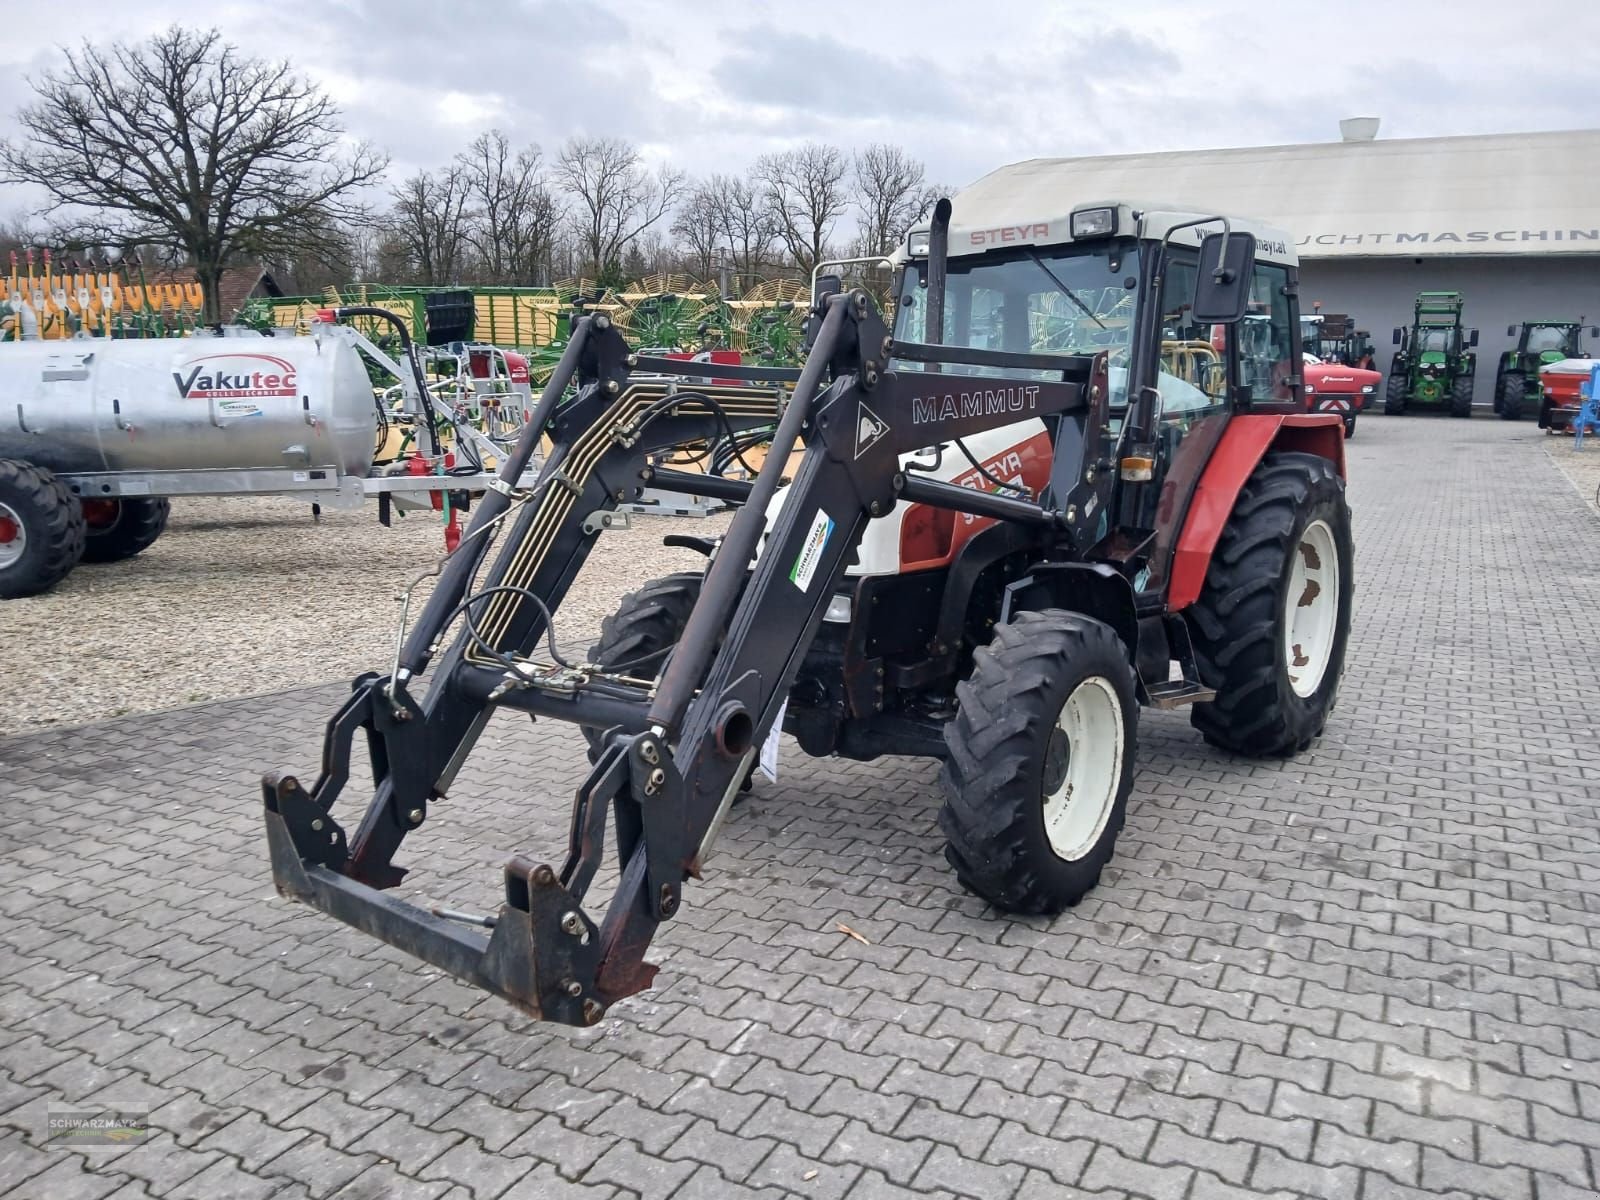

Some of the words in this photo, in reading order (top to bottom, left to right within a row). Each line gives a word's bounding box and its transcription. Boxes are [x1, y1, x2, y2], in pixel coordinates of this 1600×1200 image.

[970, 223, 1049, 245] STEYR
[172, 365, 297, 399] Vakutec
[912, 385, 1040, 424] MAMMUT
[797, 522, 822, 579] SCHWARZMAYR
